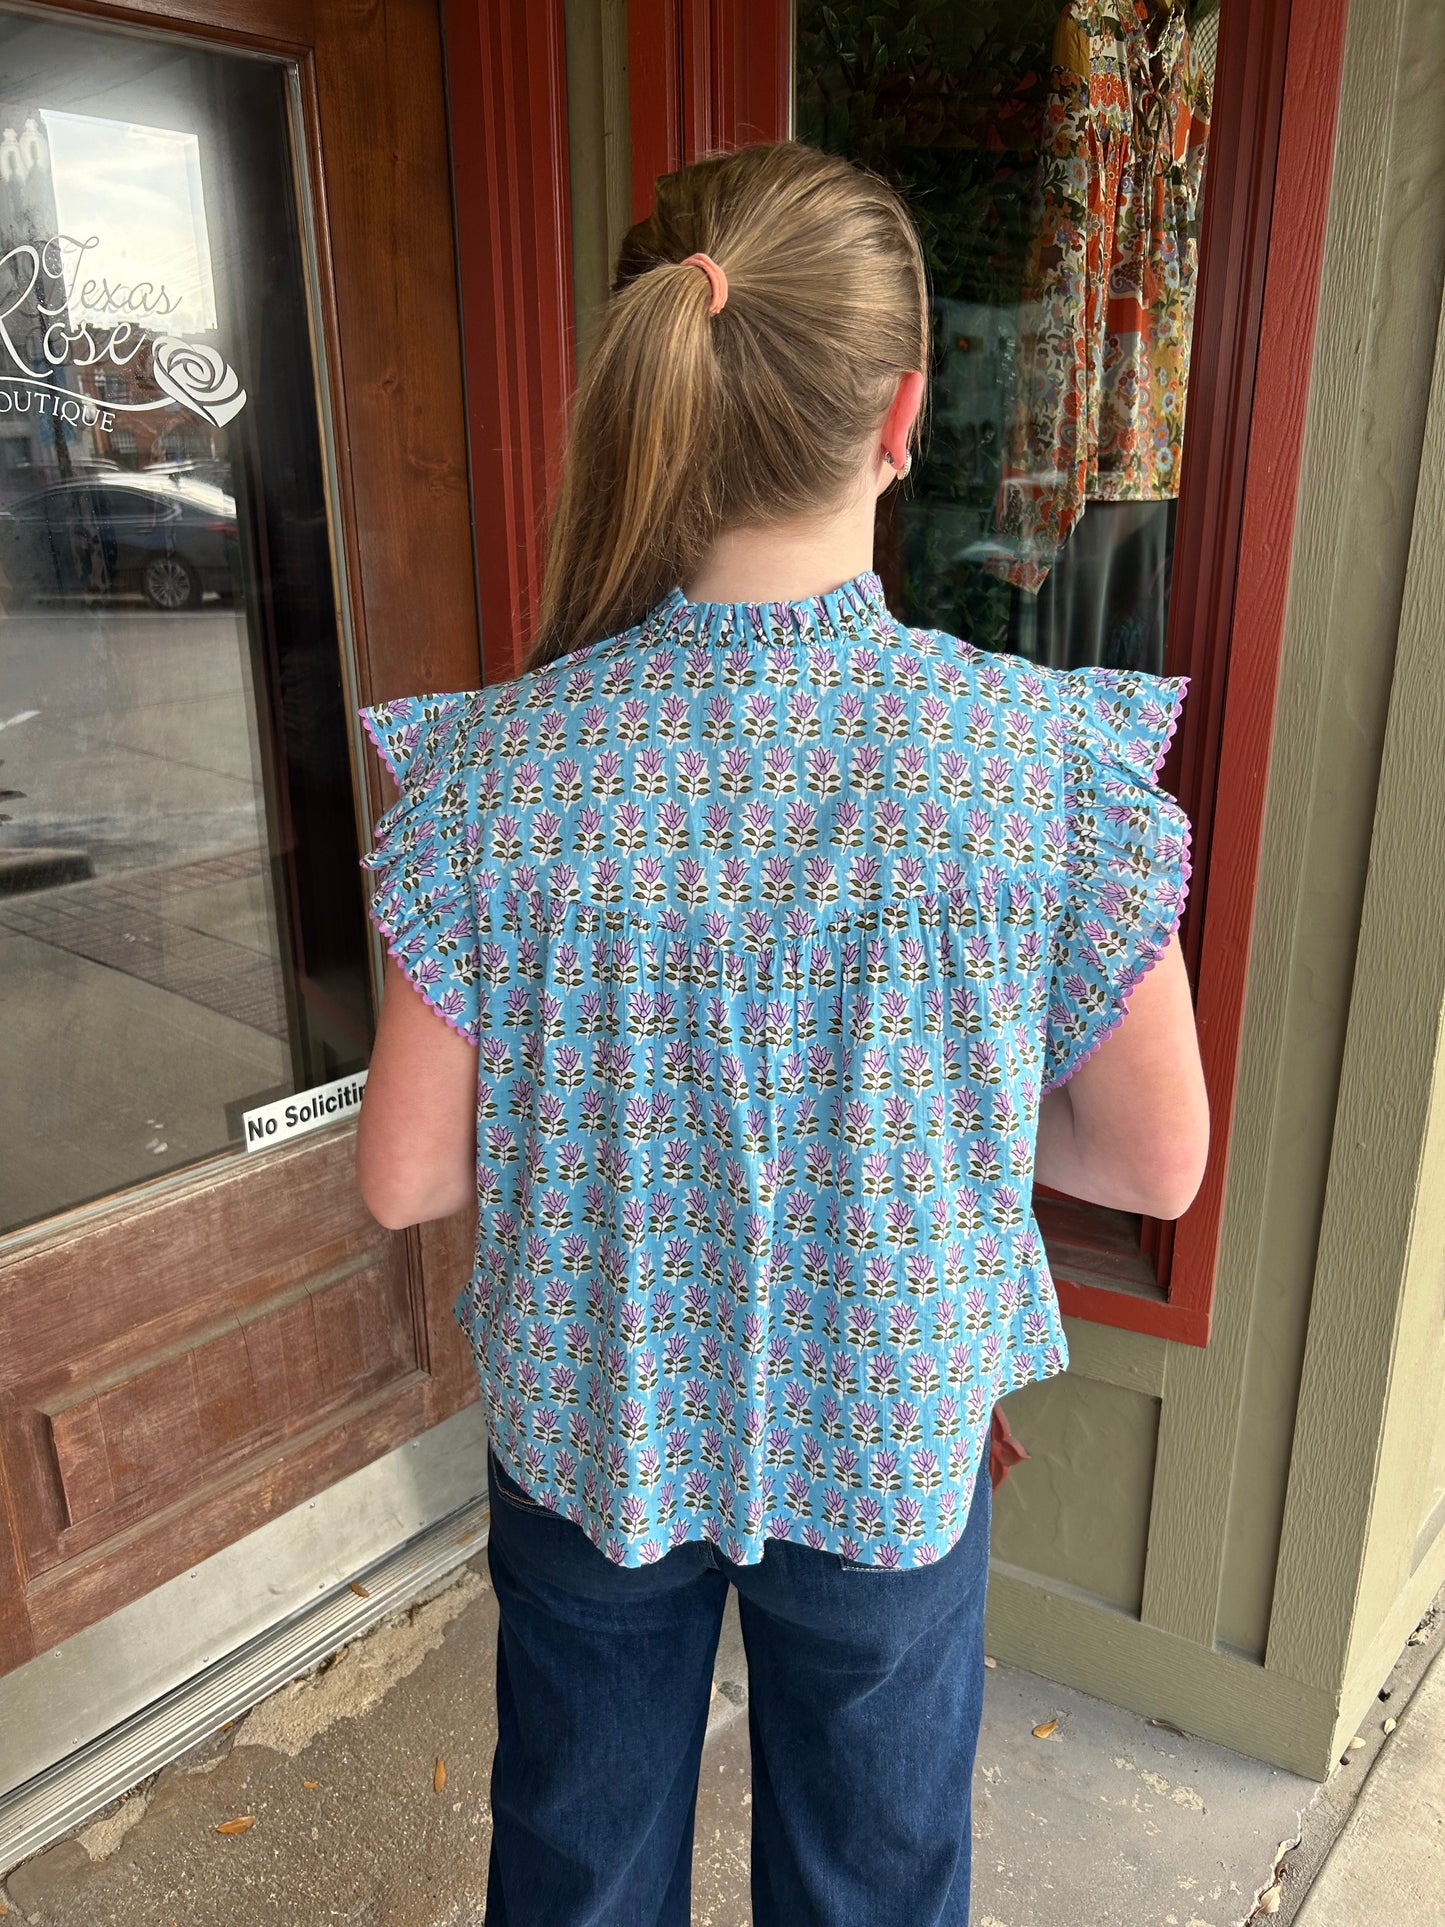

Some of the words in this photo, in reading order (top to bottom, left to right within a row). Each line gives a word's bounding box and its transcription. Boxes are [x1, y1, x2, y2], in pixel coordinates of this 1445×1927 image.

[37, 234, 182, 316] Texas
[0, 391, 116, 433] OUTIQUE
[247, 1117, 278, 1141] No
[285, 1082, 366, 1128] Solicitin
